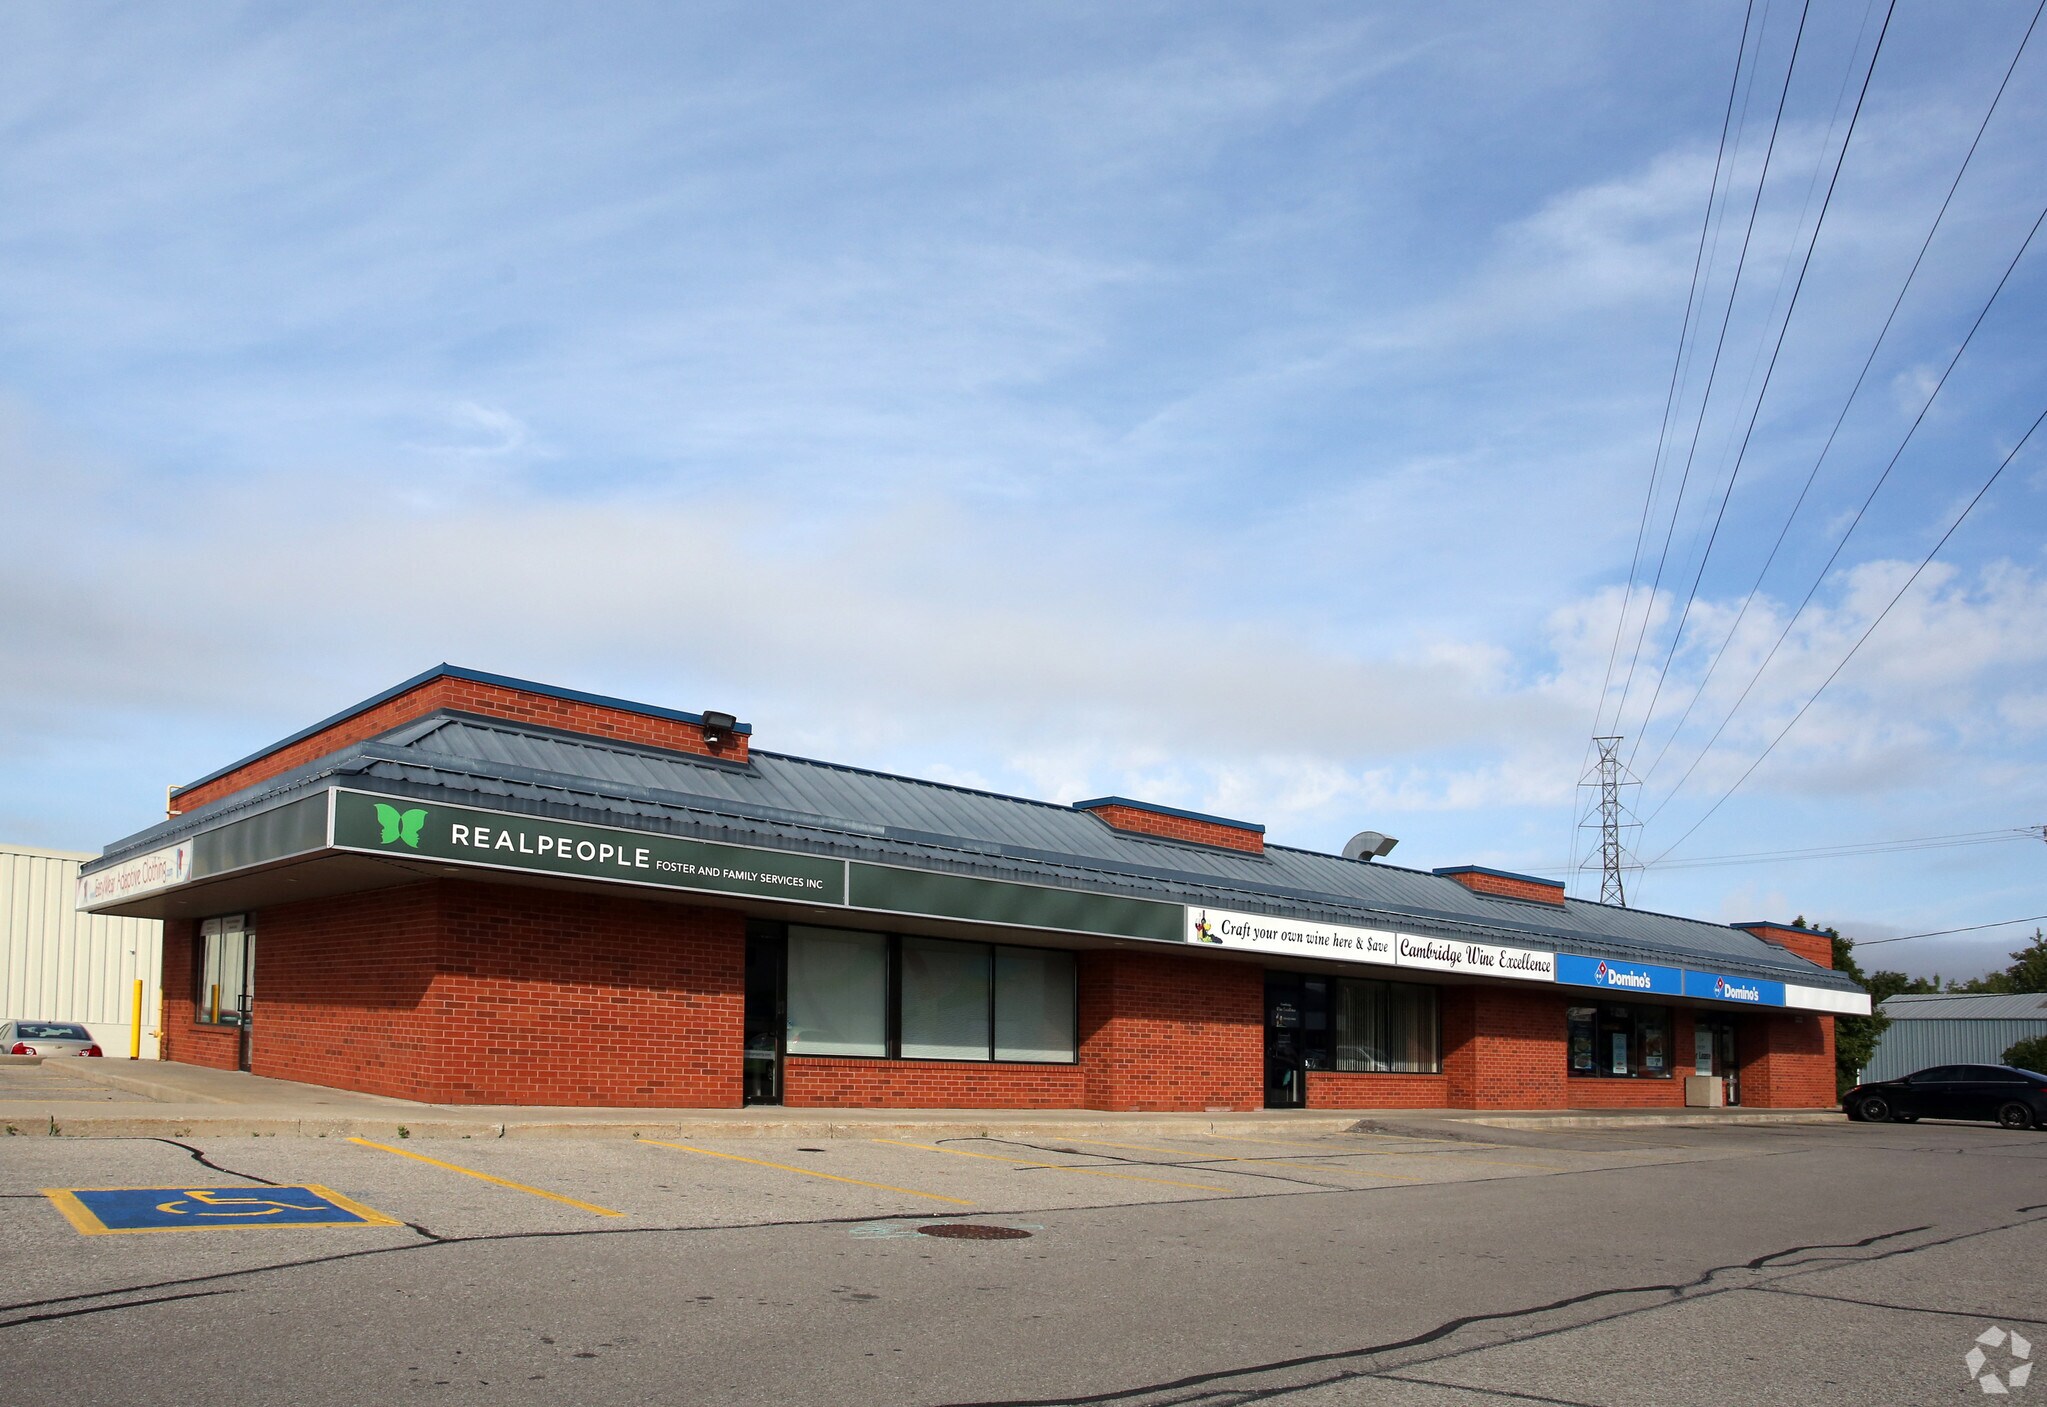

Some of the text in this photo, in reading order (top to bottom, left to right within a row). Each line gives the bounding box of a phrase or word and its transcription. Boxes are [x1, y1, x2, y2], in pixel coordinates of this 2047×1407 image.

[451, 823, 650, 868] REALPEOPLE
[142, 857, 167, 883] Clothing
[656, 860, 823, 889] FOSTER AND FAMILY SERVICES INC
[1221, 919, 1250, 940] Craft
[1253, 928, 1278, 941] your
[1281, 931, 1303, 943] own
[1306, 931, 1330, 946] wine
[1333, 933, 1353, 949] here
[1356, 936, 1364, 950] &
[1400, 939, 1551, 973] Cambridge Wine Excellence
[1608, 969, 1651, 989] Domino's
[1724, 983, 1759, 1001] Domino's
